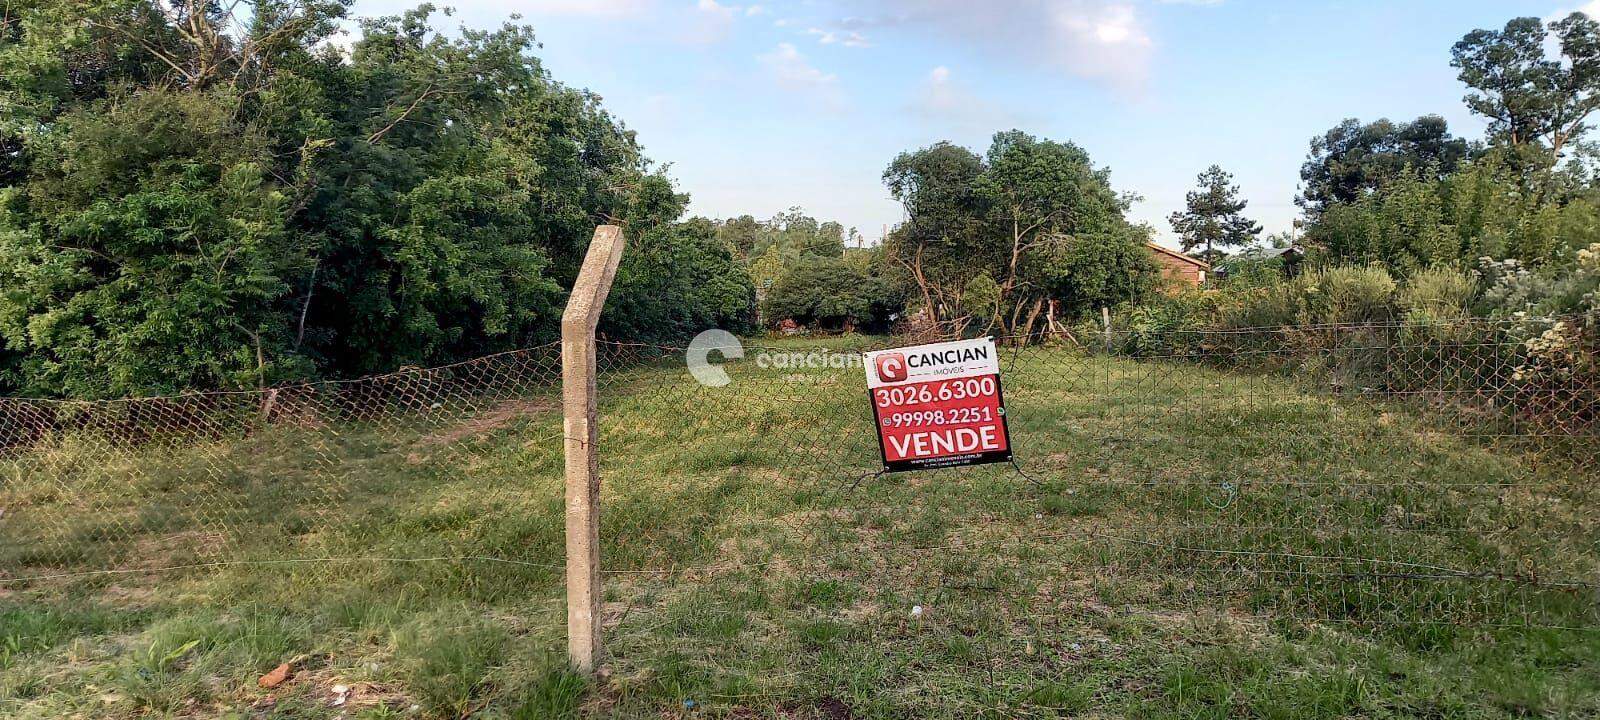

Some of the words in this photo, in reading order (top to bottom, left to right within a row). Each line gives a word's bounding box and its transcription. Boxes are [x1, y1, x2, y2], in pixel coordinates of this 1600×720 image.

[907, 346, 988, 368] CANCIAN
[876, 377, 995, 408] 3026.6300
[892, 406, 993, 428] 99998.2251
[888, 425, 999, 458] VENDE
